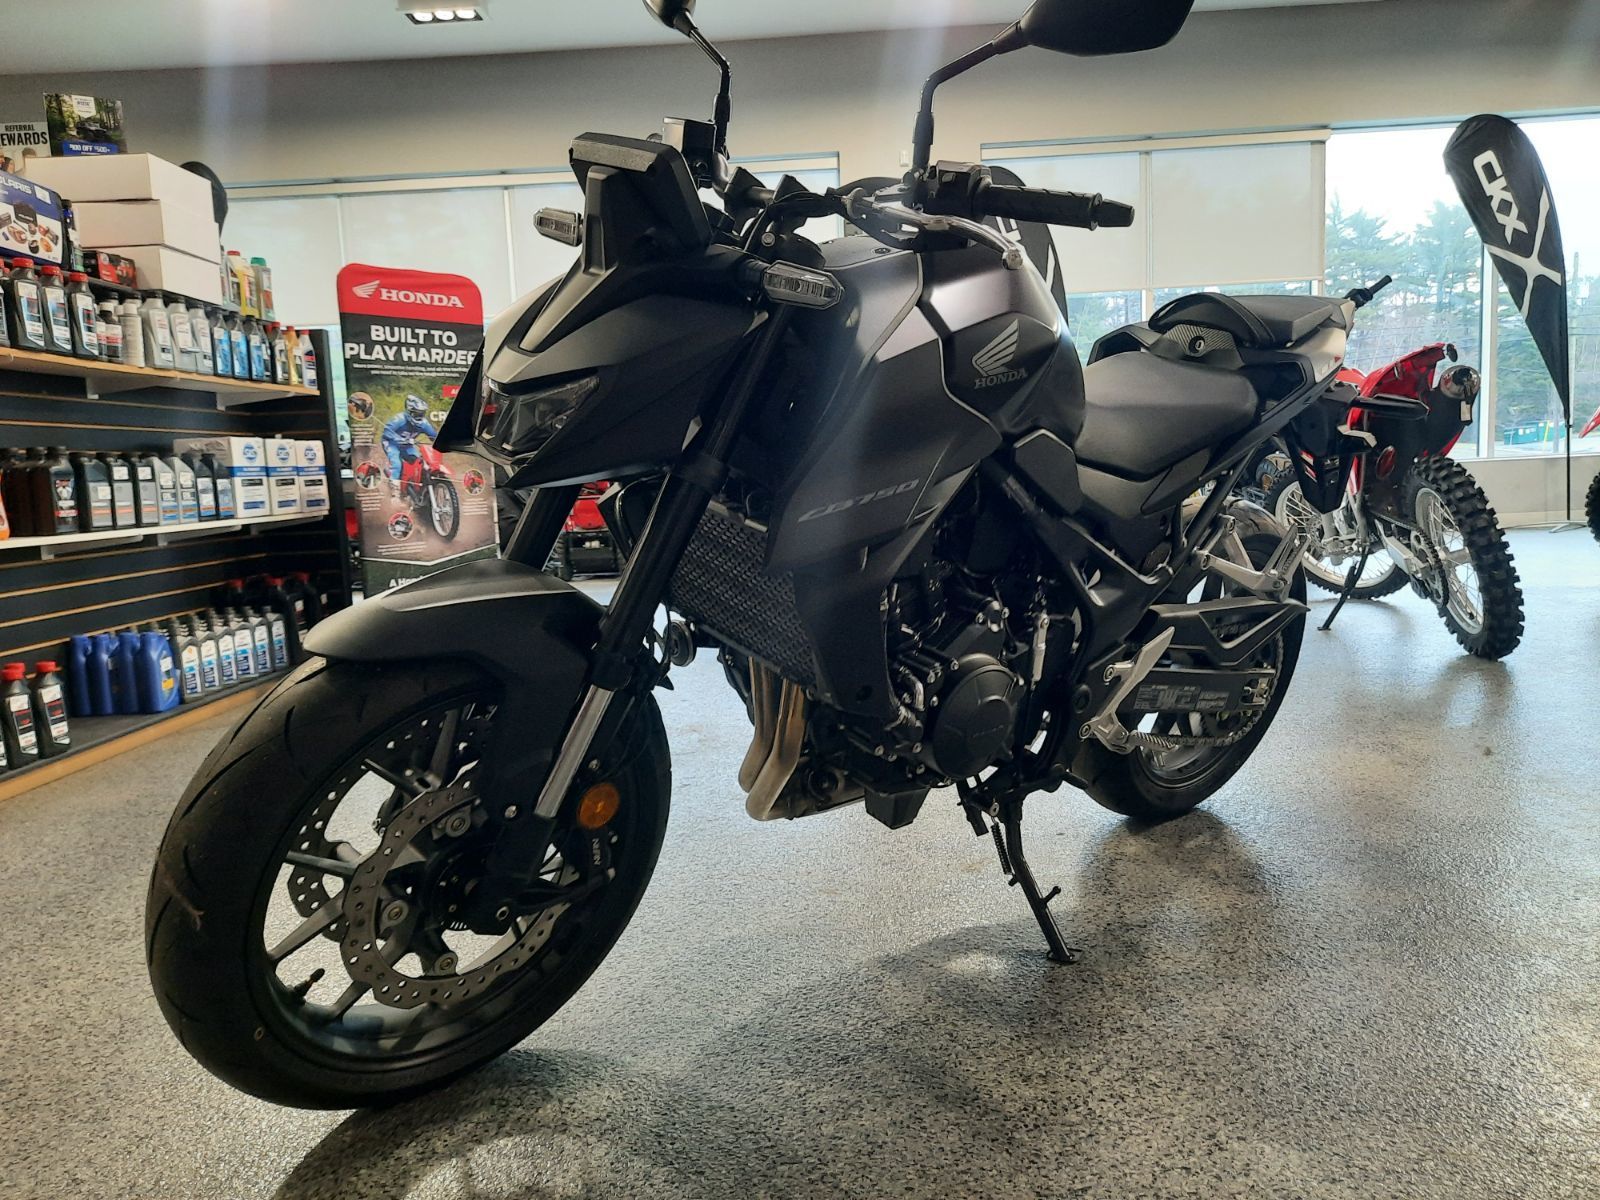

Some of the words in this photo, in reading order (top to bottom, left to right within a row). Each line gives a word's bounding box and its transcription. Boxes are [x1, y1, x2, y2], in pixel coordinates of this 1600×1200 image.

[4, 124, 36, 132] REFERRAL
[82, 144, 93, 152] OFF
[1473, 150, 1529, 245] CKX
[379, 288, 464, 308] HONDA
[370, 324, 429, 345] BUILT
[429, 329, 458, 346] TO
[344, 342, 398, 361] PLAY
[973, 368, 1028, 390] HONDA
[388, 578, 399, 590] A
